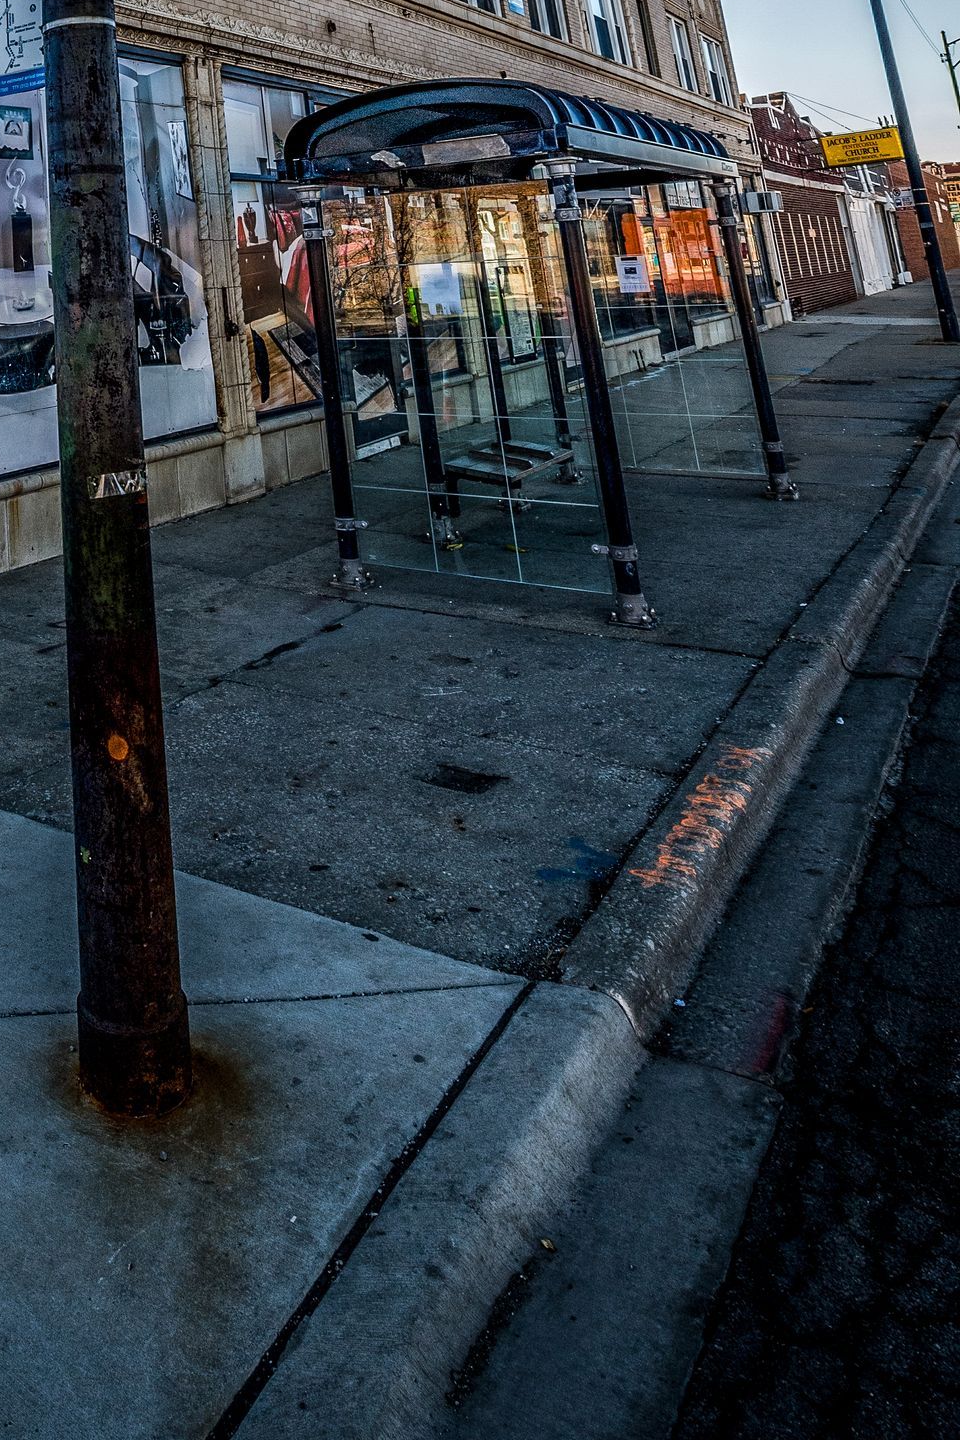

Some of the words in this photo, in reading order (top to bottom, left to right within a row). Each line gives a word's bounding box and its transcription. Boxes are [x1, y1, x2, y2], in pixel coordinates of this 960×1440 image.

[826, 136, 857, 147] JACOB'S
[860, 131, 893, 142] LADDER
[842, 141, 878, 150] PENTECOSTAL
[845, 146, 880, 157] CHURCH
